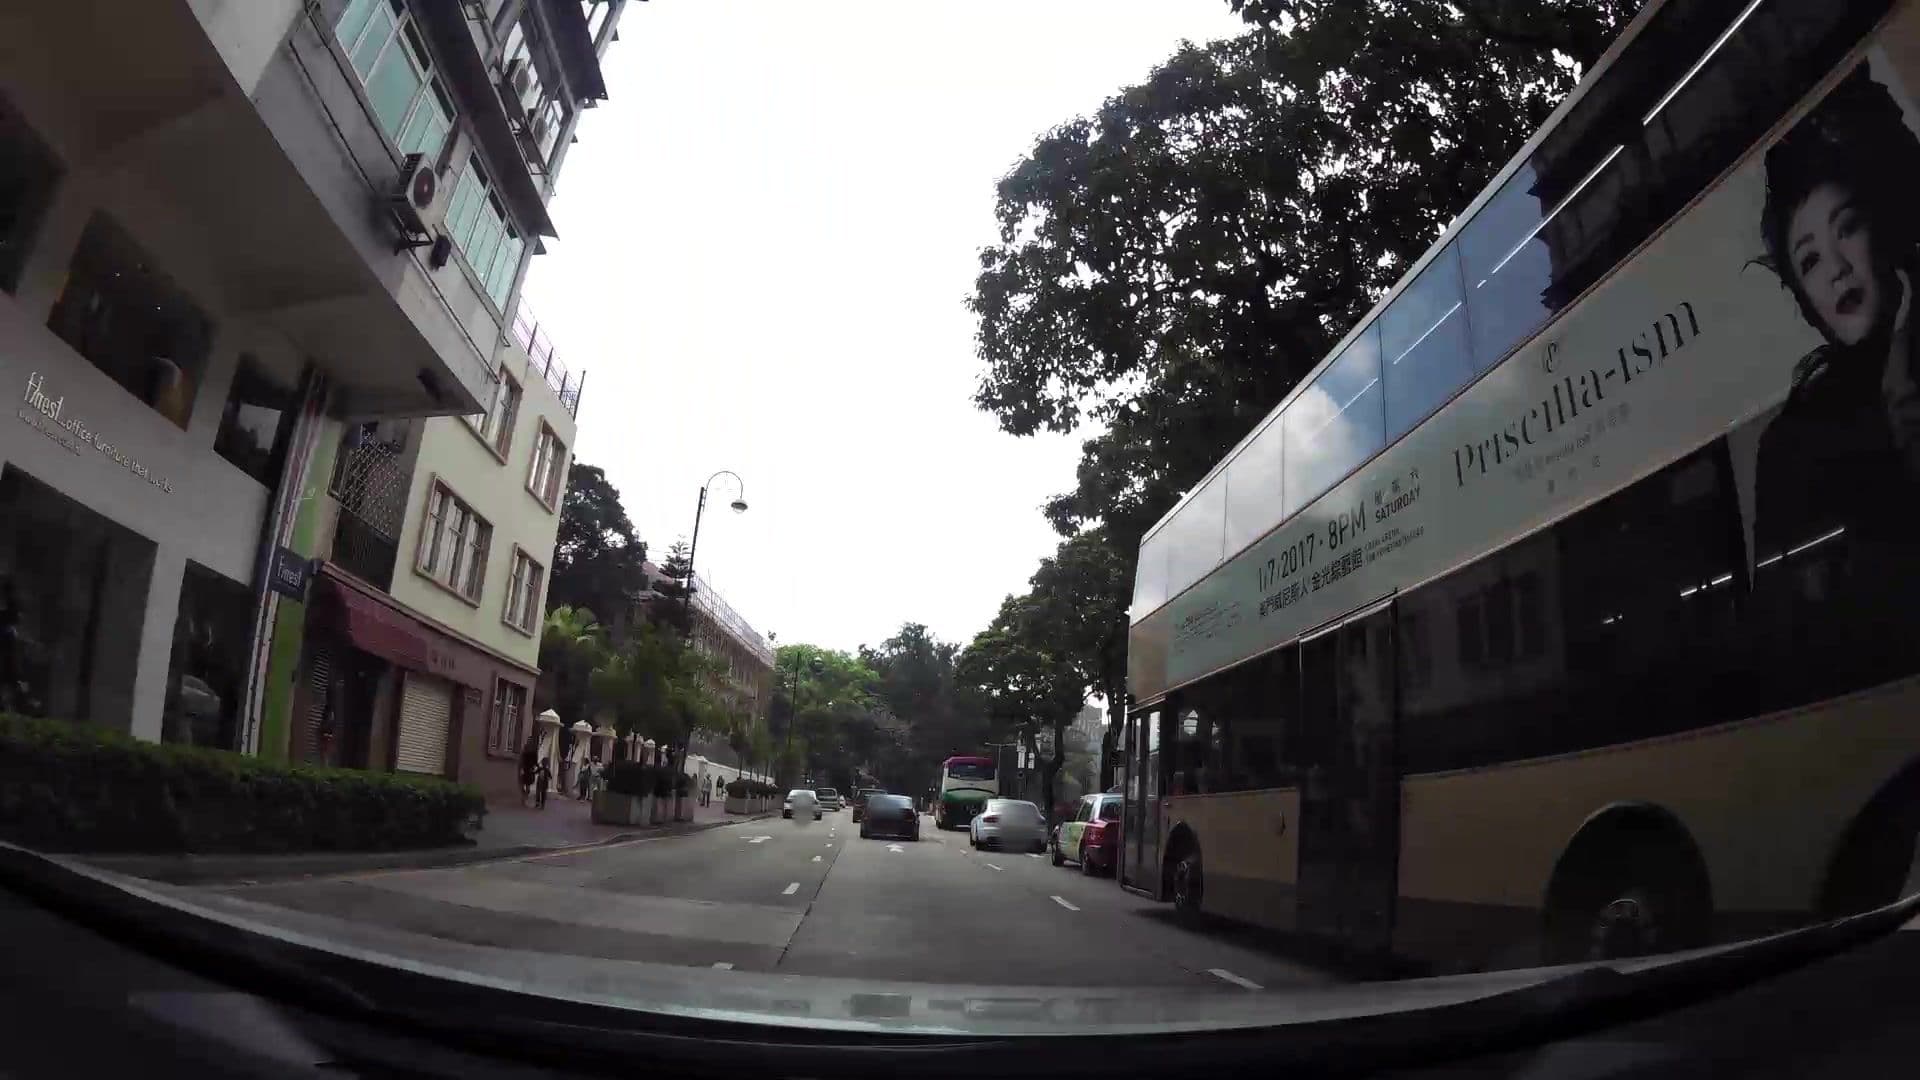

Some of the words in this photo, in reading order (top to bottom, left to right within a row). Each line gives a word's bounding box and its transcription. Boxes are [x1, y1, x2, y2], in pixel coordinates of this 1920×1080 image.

[1454, 301, 1701, 488] Priscilla-ism
[94, 431, 130, 467] furniture
[1375, 484, 1420, 523] SATURDAY
[1327, 502, 1367, 550] 8PM
